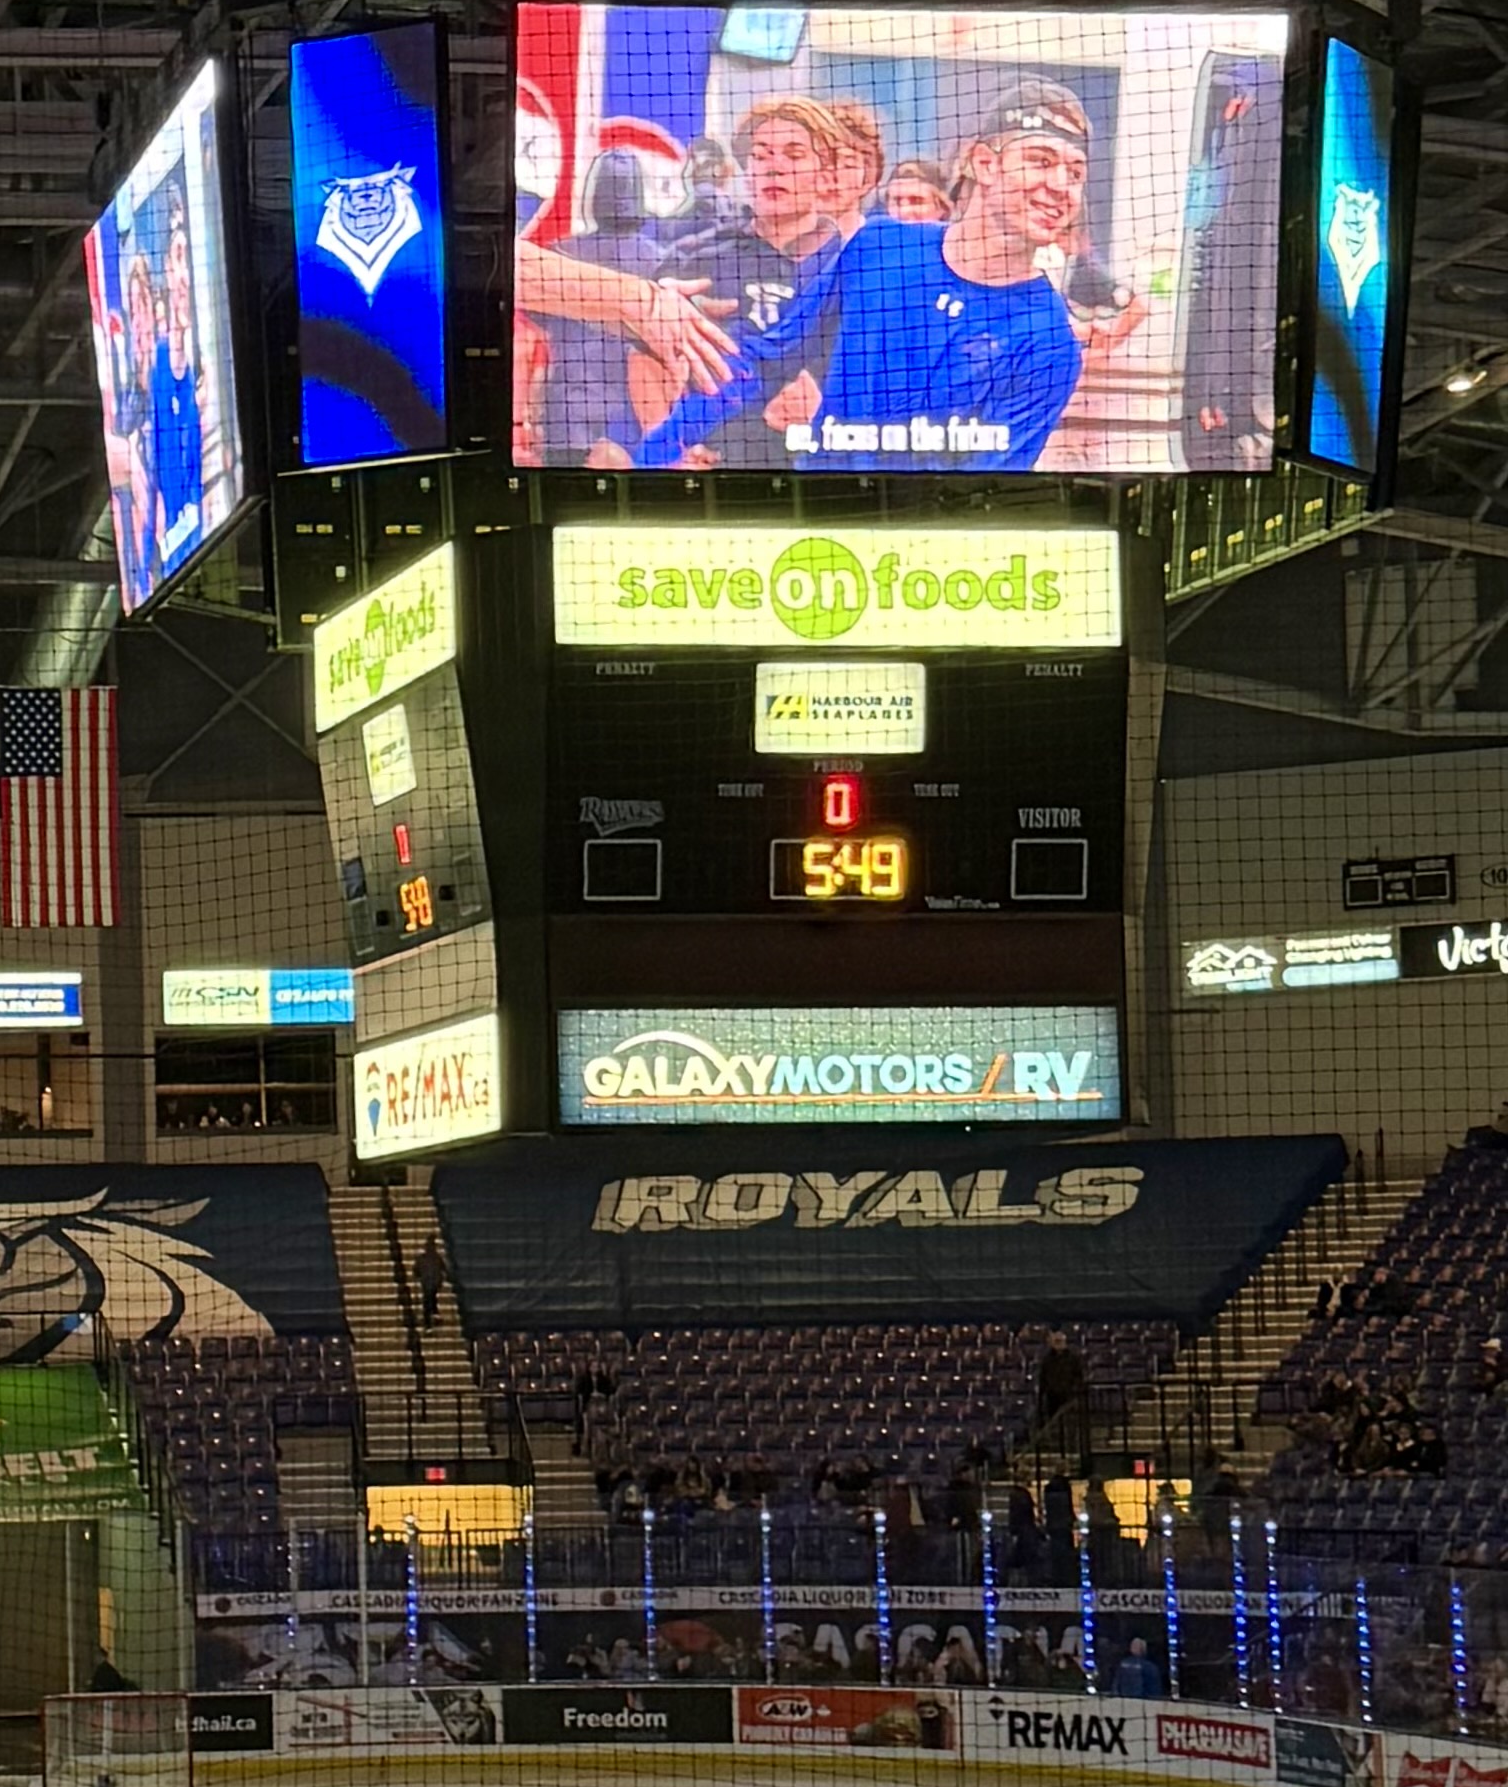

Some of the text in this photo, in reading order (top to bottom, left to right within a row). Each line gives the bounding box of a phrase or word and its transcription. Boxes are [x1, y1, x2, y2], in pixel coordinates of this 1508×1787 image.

[910, 415, 944, 451] the
[948, 415, 1010, 451] future
[812, 695, 913, 707] HARBOUR AIR
[812, 709, 913, 720] SEAPLANES
[824, 782, 853, 825] 0
[1018, 807, 1082, 829] VISITOR
[803, 843, 900, 897] 5:49
[1013, 1050, 1091, 1099] RV
[593, 1166, 1145, 1233] ROYALS
[515, 1592, 560, 1606] ZNE
[803, 1589, 868, 1605] LIQUOR
[563, 1707, 668, 1728] Freedom
